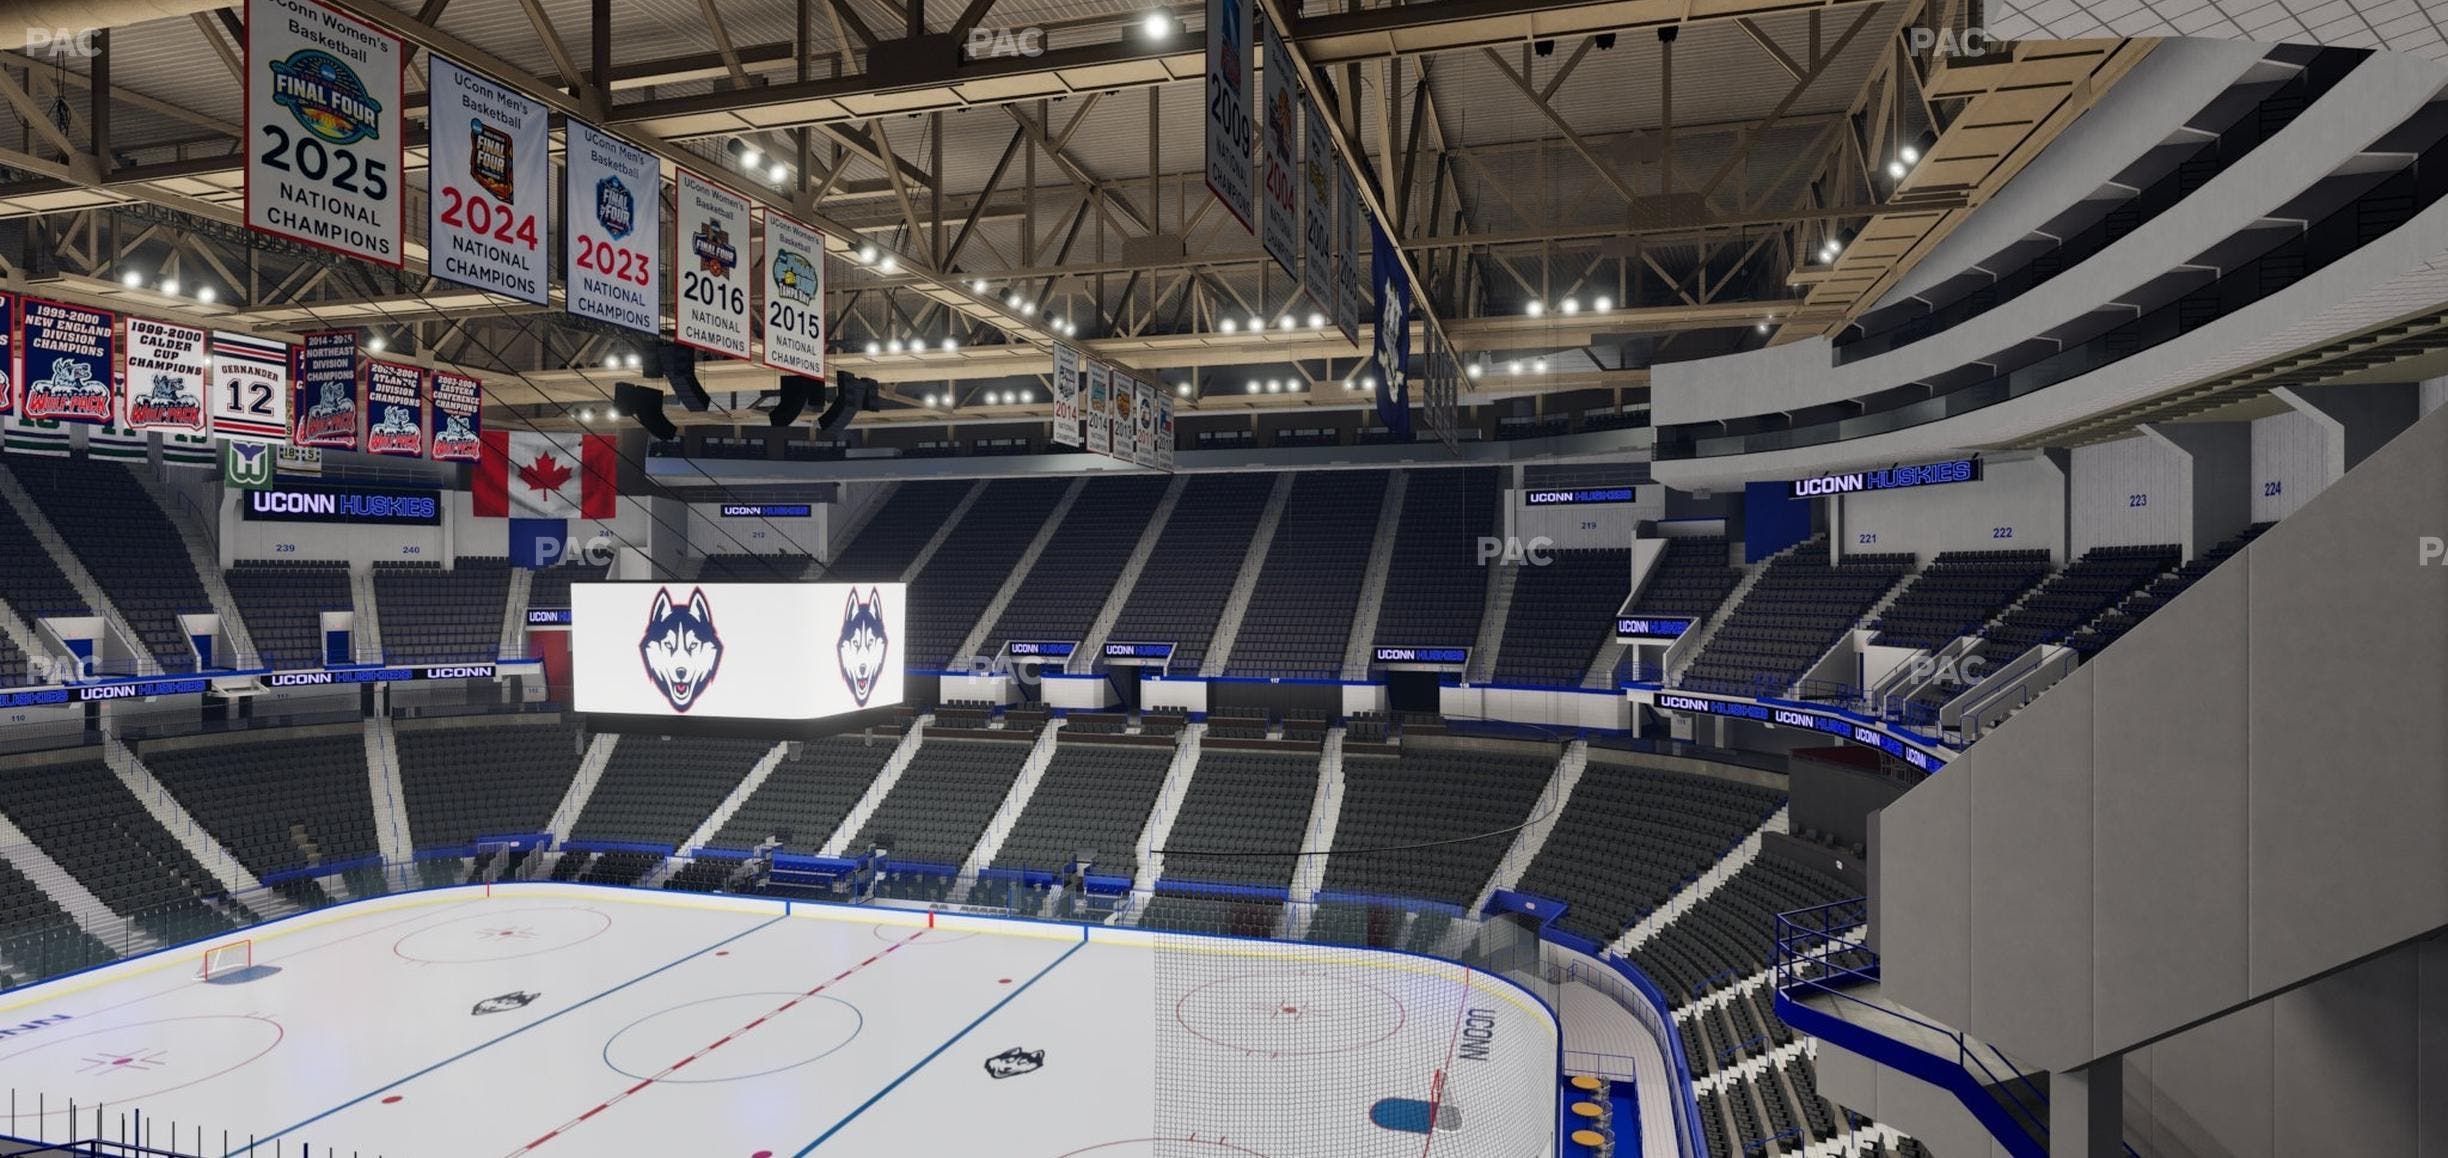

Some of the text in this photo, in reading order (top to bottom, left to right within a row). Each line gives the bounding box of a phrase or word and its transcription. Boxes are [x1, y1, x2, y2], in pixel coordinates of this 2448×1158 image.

[268, 0, 388, 53] Conn Women's
[289, 19, 366, 63] Basketball
[277, 74, 376, 127] FINAL FOUR
[454, 72, 528, 115] UConn Men's
[462, 94, 520, 130] Basketball
[1211, 73, 1250, 159] 2009
[477, 134, 505, 157] FINAL
[584, 130, 644, 165] UConn Men's
[261, 124, 387, 201] 2025
[477, 150, 505, 174] FOUR
[591, 150, 639, 179] Basketball
[684, 177, 710, 196] UConn
[1266, 151, 1295, 215] 2004
[280, 181, 381, 227] NATIONAL
[441, 186, 538, 251] 2024
[268, 207, 390, 254] CHAMPIONS
[453, 234, 529, 271] NATIONAL
[576, 234, 649, 286] 2023
[446, 257, 535, 294] CHAMPIONS
[583, 277, 646, 307] NATIONAL
[684, 271, 744, 315] 2016
[37, 305, 99, 324] 1999-2000
[578, 298, 650, 328] CHAMPIONS
[692, 309, 741, 333] NATIONAL
[770, 301, 819, 339] 2015
[25, 314, 112, 337] NEW ENGLAND
[131, 322, 201, 342] 1999-2000
[42, 328, 96, 346] DIVISION
[140, 335, 192, 352] CALDER
[686, 326, 745, 352] CHAMPIONS
[776, 334, 816, 356] NATIONAL
[33, 338, 104, 357] CHAMPIONS
[153, 349, 179, 360] CUP
[307, 346, 354, 358] NORTHEAST
[129, 357, 202, 376] CHAMPIONS
[313, 359, 348, 369] DIVISION
[772, 350, 820, 373] CHAMPIONS
[221, 365, 279, 382] GERNANDER
[306, 370, 354, 382] CHAMPIONS
[227, 377, 274, 417] 12
[375, 383, 414, 397] DIVISION
[433, 391, 480, 405] CONFERENCE
[440, 384, 474, 396] EASTERN
[369, 392, 421, 408] CHAMPIONS
[435, 399, 478, 413] CHAMPIONS
[1055, 400, 1077, 422] 2014
[1795, 461, 1971, 496] UCONN HUSKIES
[1530, 492, 1573, 502] UCONN
[2264, 481, 2281, 497] 224
[254, 491, 434, 518] UCONN HUSKIES
[2129, 494, 2147, 507] 223
[724, 506, 761, 515] UCONN
[1860, 533, 1877, 544] 221
[1993, 528, 2012, 538] 222
[276, 543, 295, 552] 239
[529, 611, 558, 622] UCONN
[1619, 620, 1649, 633] UCONN
[1011, 643, 1039, 653] UCONN
[1106, 645, 1134, 655] UCONN
[1378, 649, 1415, 660] UCONN
[272, 673, 332, 686] UCONN
[427, 667, 492, 678] UCONN
[80, 685, 136, 700] UCONN
[1661, 695, 1708, 711] UCONN
[1775, 710, 1813, 728] UCONN
[1855, 727, 1880, 746] UCONN
[0, 1014, 73, 1039] NN
[1459, 1008, 1496, 1061] UCONN
